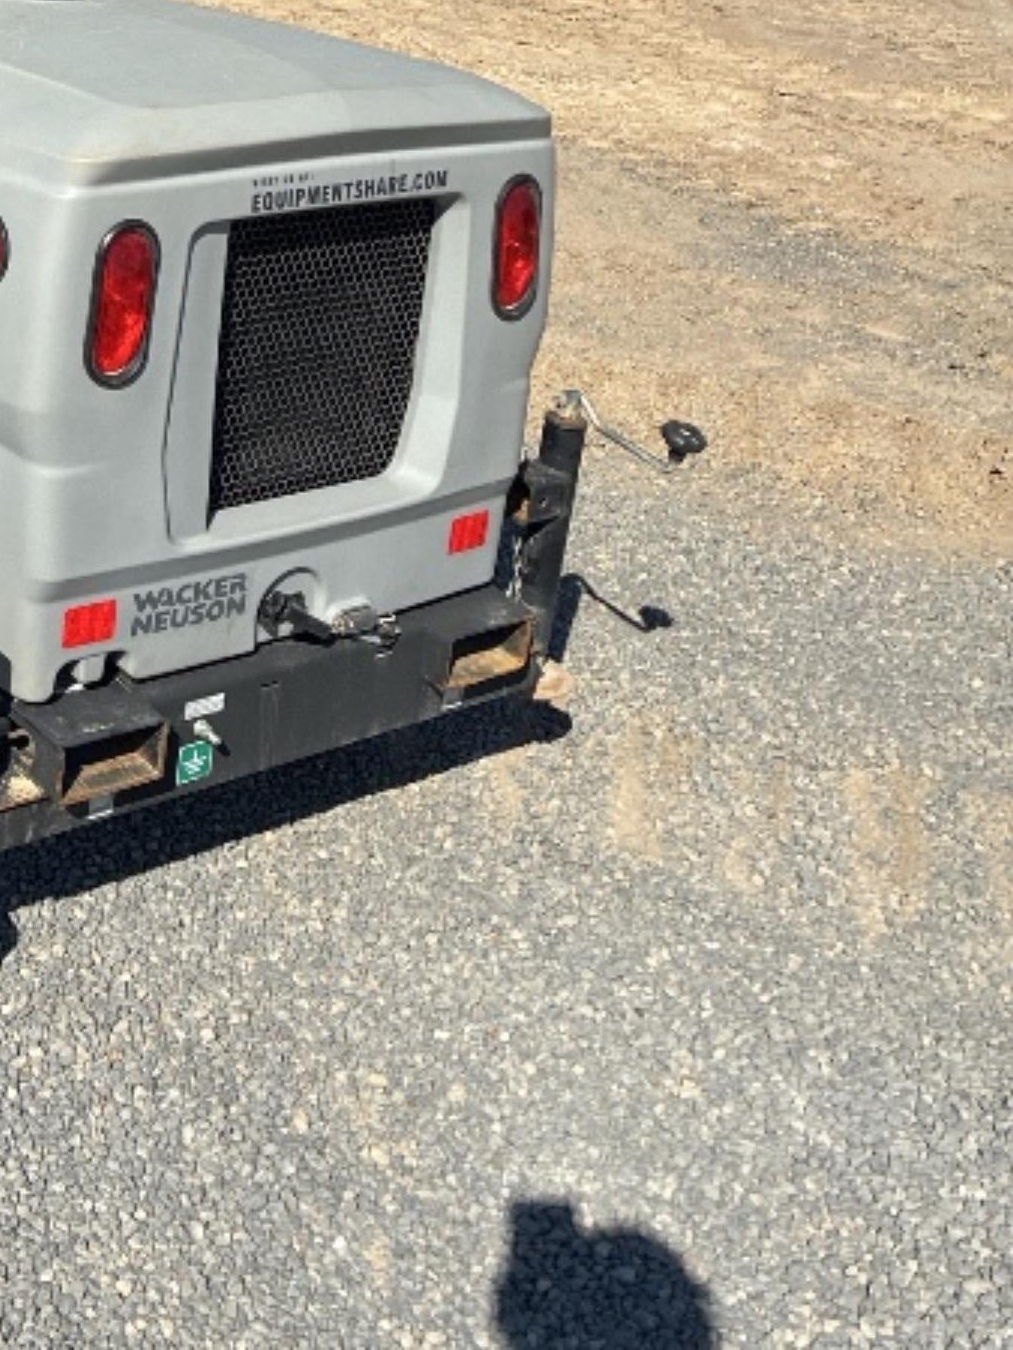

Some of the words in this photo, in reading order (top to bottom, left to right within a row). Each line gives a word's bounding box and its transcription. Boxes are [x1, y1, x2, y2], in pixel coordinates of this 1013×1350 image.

[251, 170, 449, 214] EQUIPMENTSHARE.COM
[133, 572, 246, 612] WACKER
[130, 593, 246, 637] NEUSON
